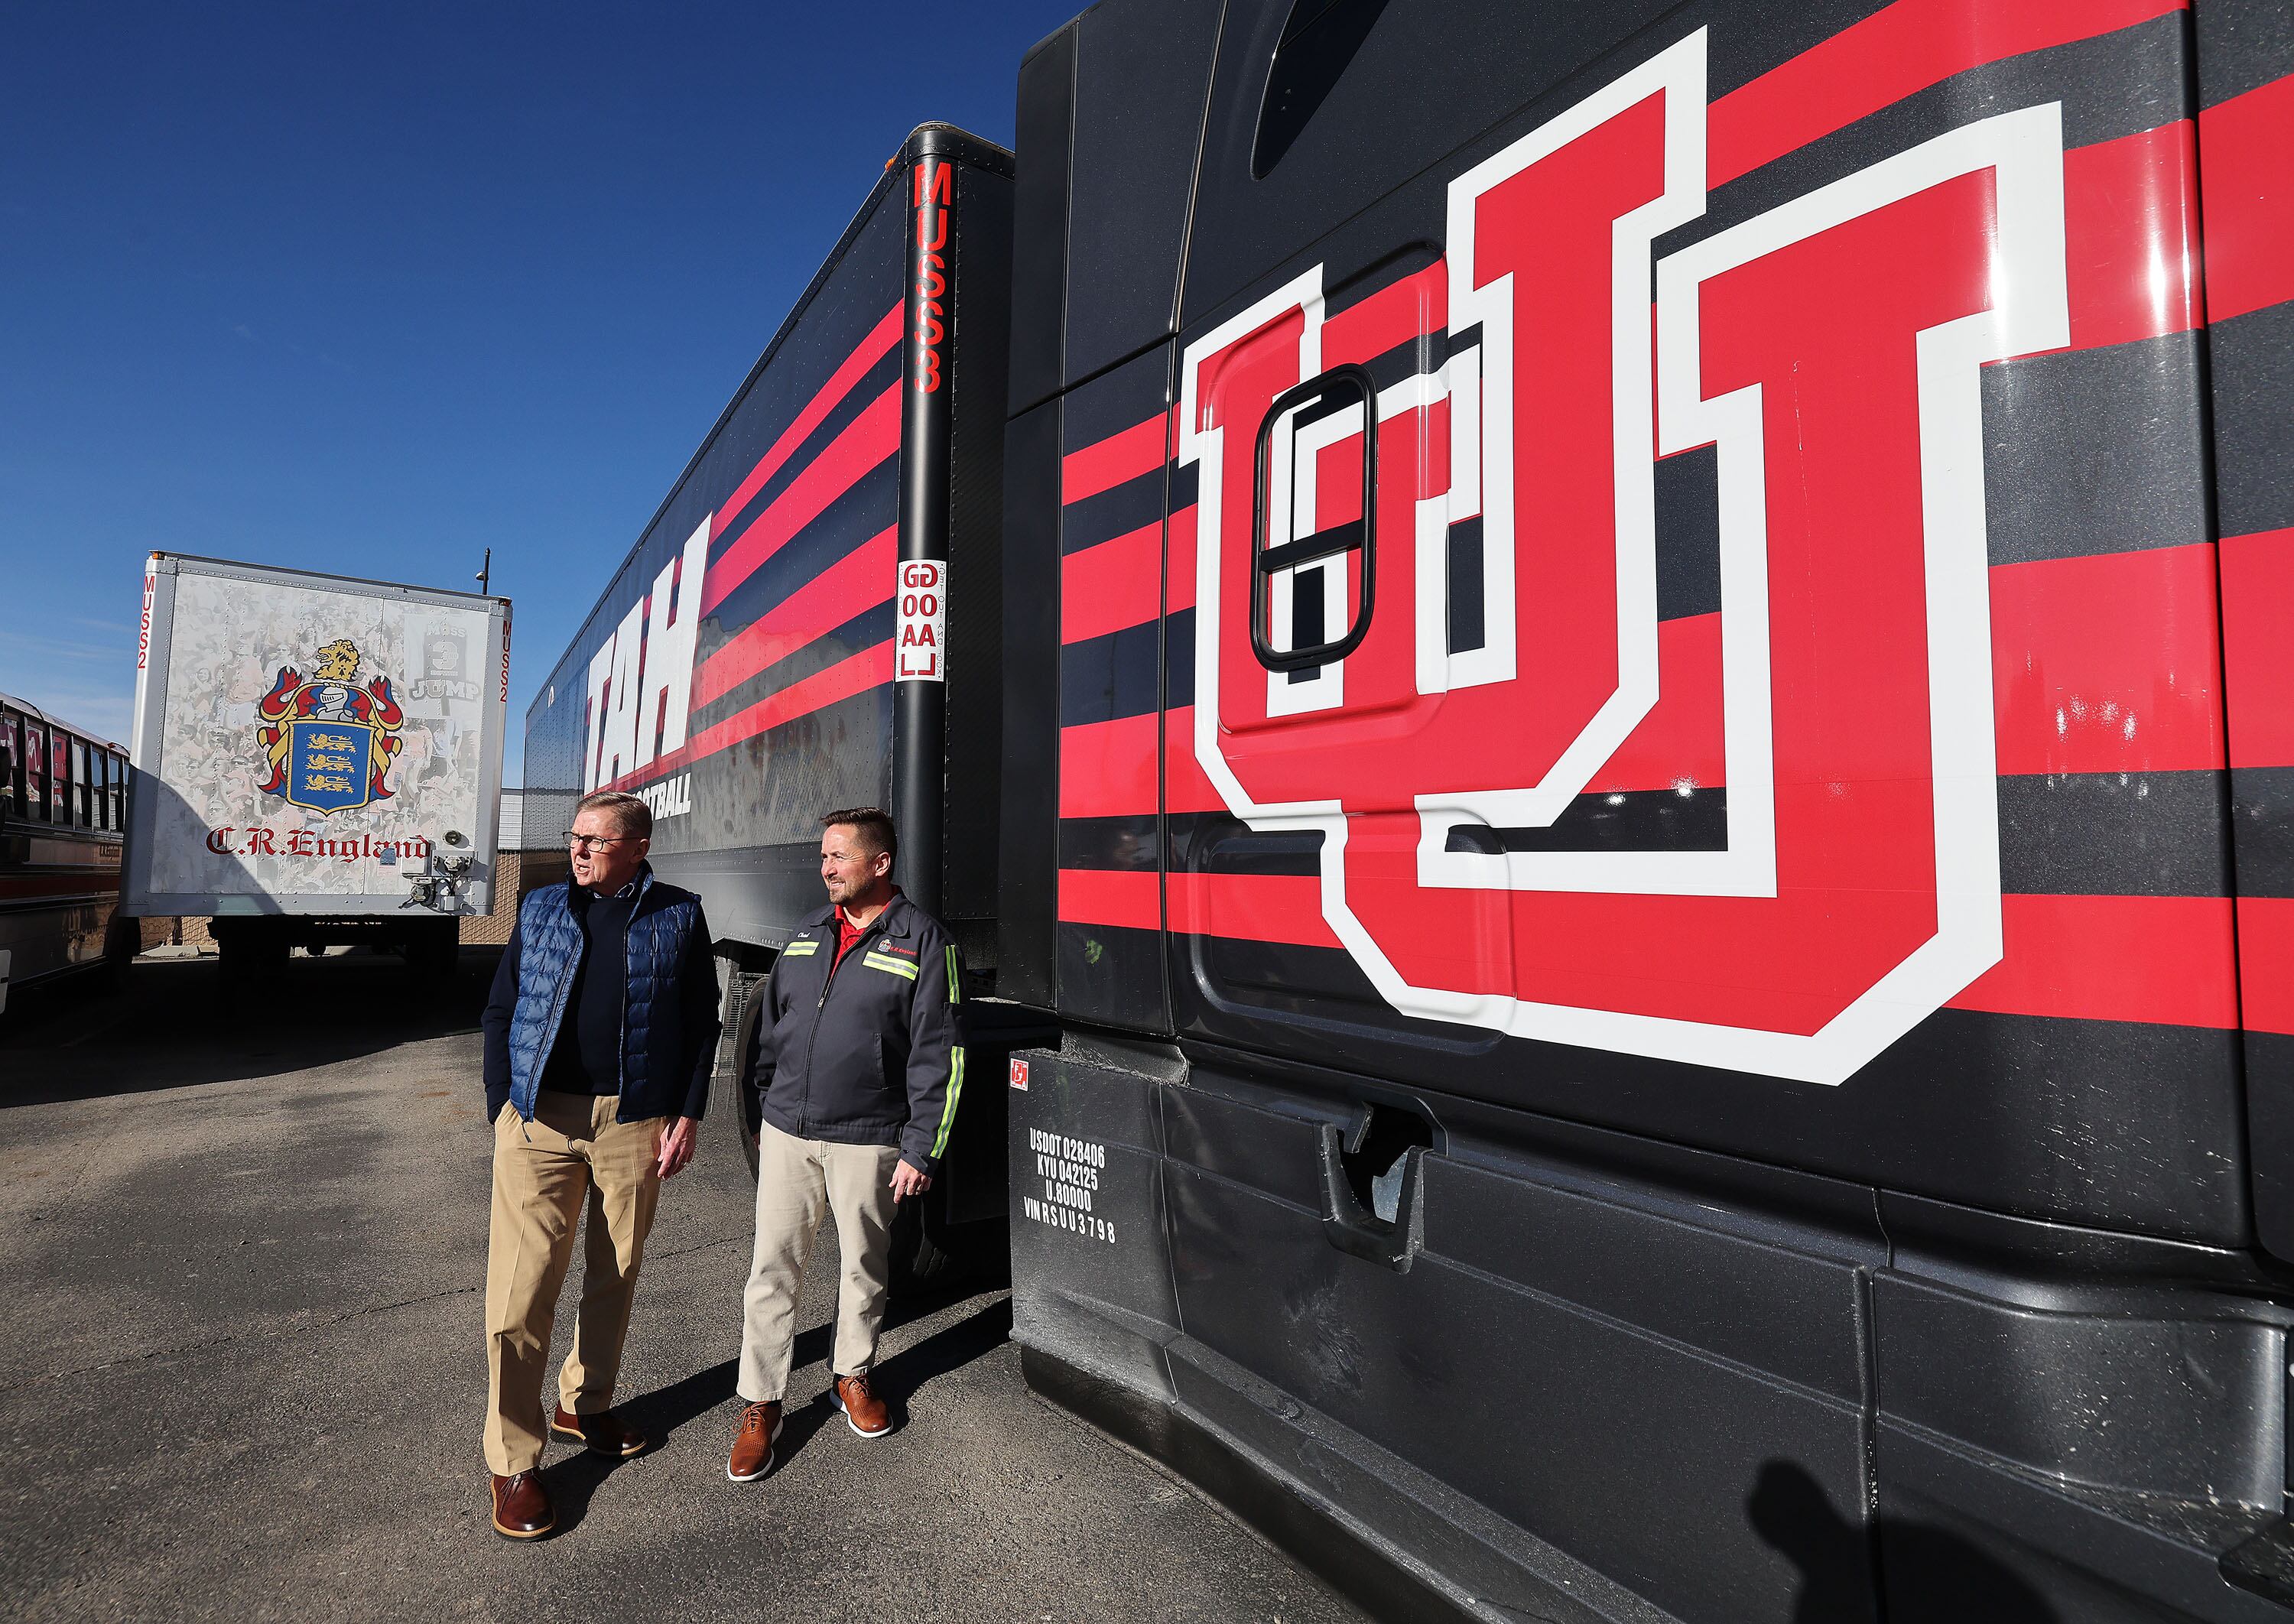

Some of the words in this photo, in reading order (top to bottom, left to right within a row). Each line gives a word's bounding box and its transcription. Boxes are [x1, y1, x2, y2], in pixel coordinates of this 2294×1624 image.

[914, 162, 951, 393] MUSS3
[138, 576, 155, 668] MUSS2
[500, 620, 512, 702] MUSS2
[1029, 1127, 1061, 1157] USDOT
[1063, 1135, 1105, 1168] 028406
[1037, 1153, 1058, 1180] KYU
[1058, 1158, 1098, 1190] 042125
[1045, 1179, 1092, 1212] U.80000
